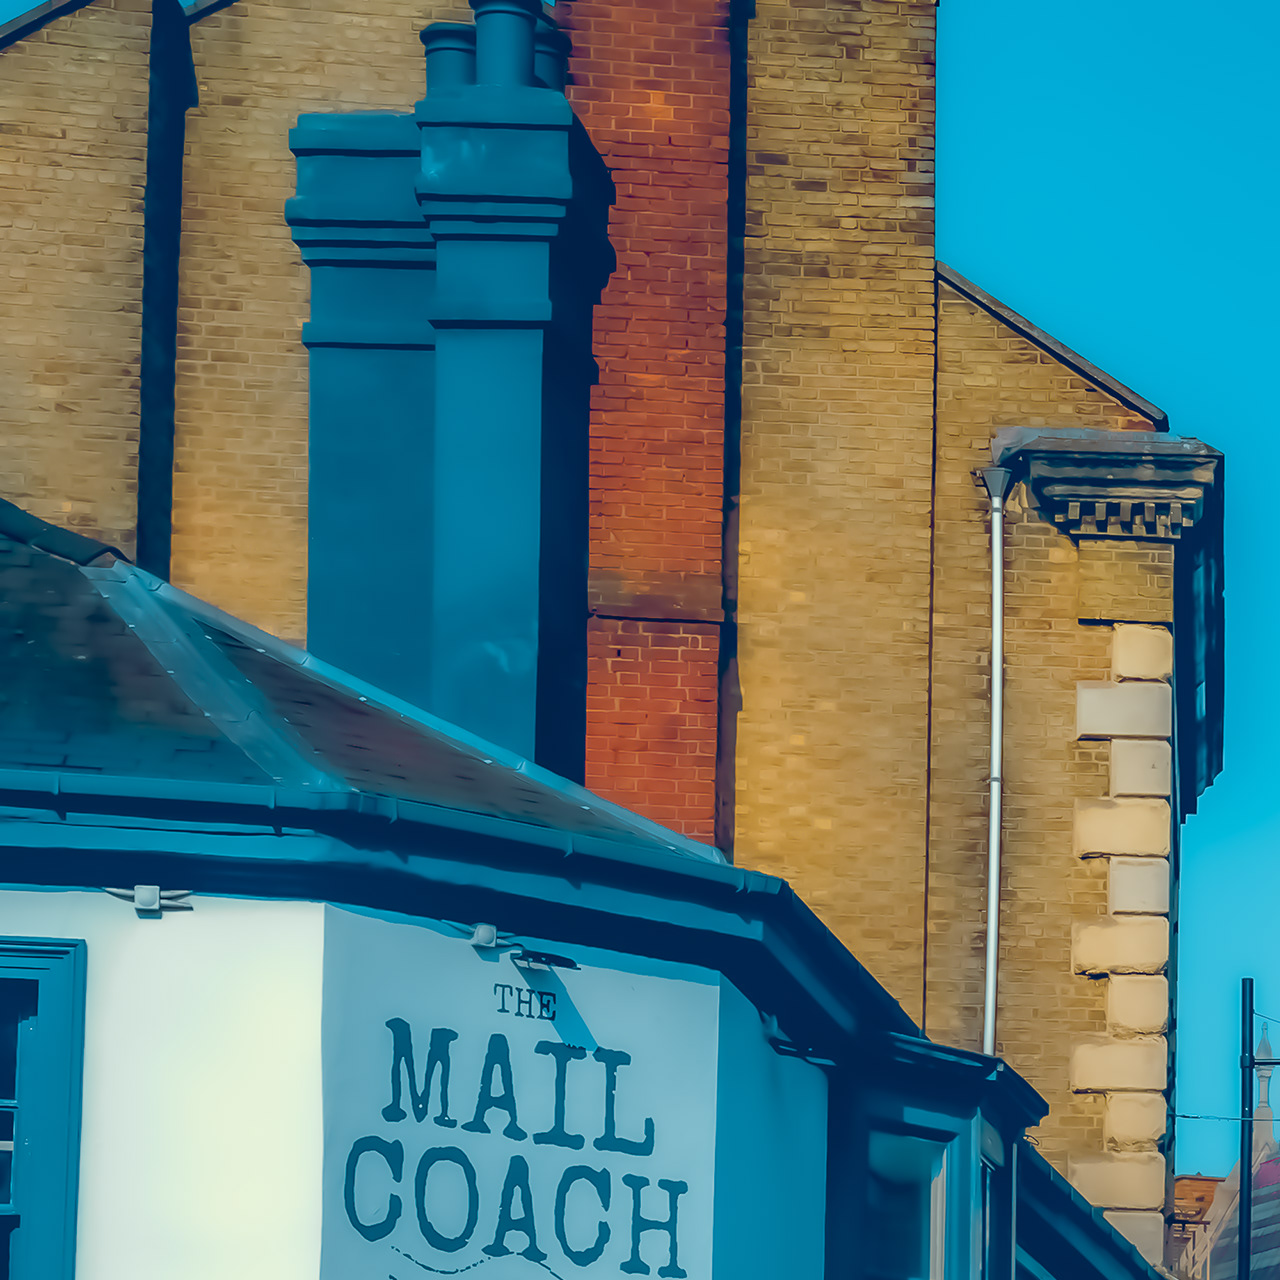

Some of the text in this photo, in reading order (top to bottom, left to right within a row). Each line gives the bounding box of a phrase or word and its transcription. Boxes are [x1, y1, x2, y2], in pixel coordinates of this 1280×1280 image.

[494, 983, 557, 1021] THE
[381, 1016, 655, 1156] MAIL
[343, 1135, 689, 1279] COACH
